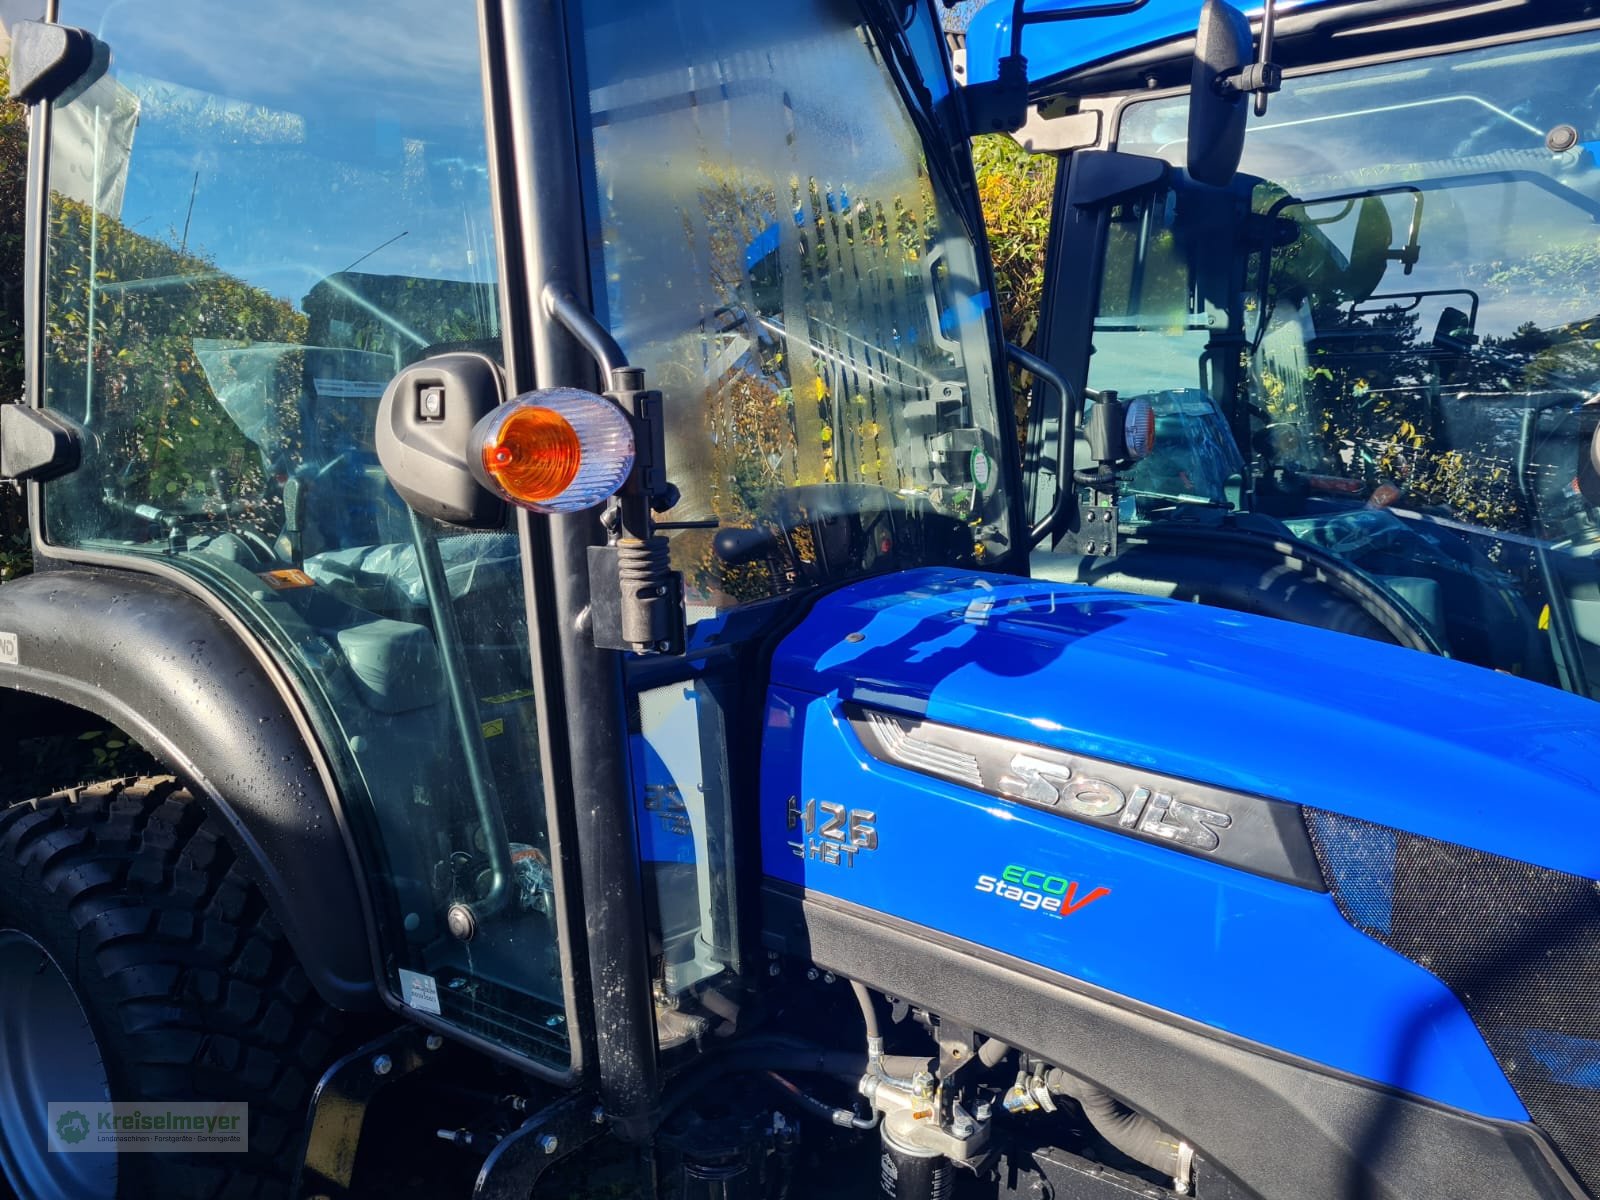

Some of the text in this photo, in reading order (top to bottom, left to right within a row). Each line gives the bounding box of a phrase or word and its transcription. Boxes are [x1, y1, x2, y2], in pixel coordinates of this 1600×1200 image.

[787, 795, 878, 850] H26
[809, 838, 859, 869] HST
[1002, 864, 1069, 895] ECO
[1060, 881, 1112, 917] V
